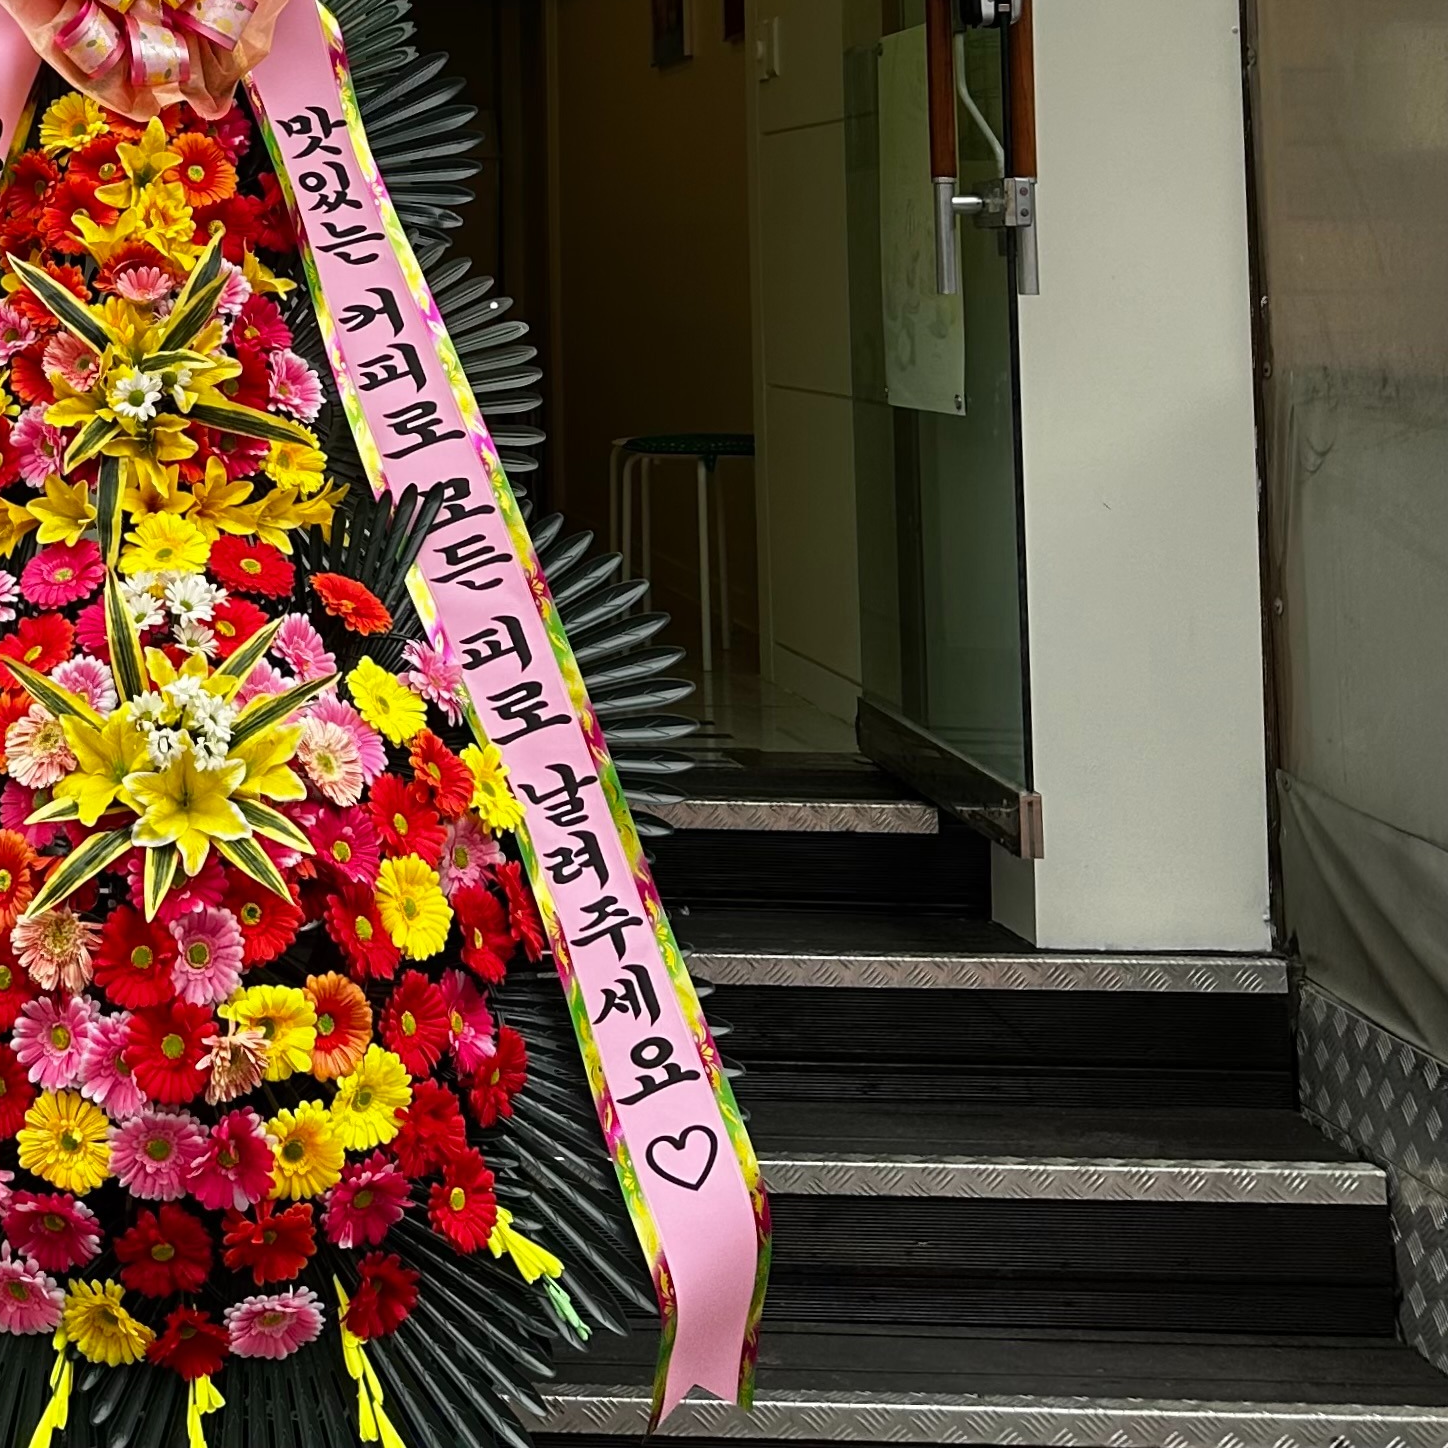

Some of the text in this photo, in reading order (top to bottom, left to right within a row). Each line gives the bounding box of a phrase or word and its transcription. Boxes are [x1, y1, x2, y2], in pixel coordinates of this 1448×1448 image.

[274, 105, 701, 1107] 맛있는 커피로 모든 피로 날려주세요
